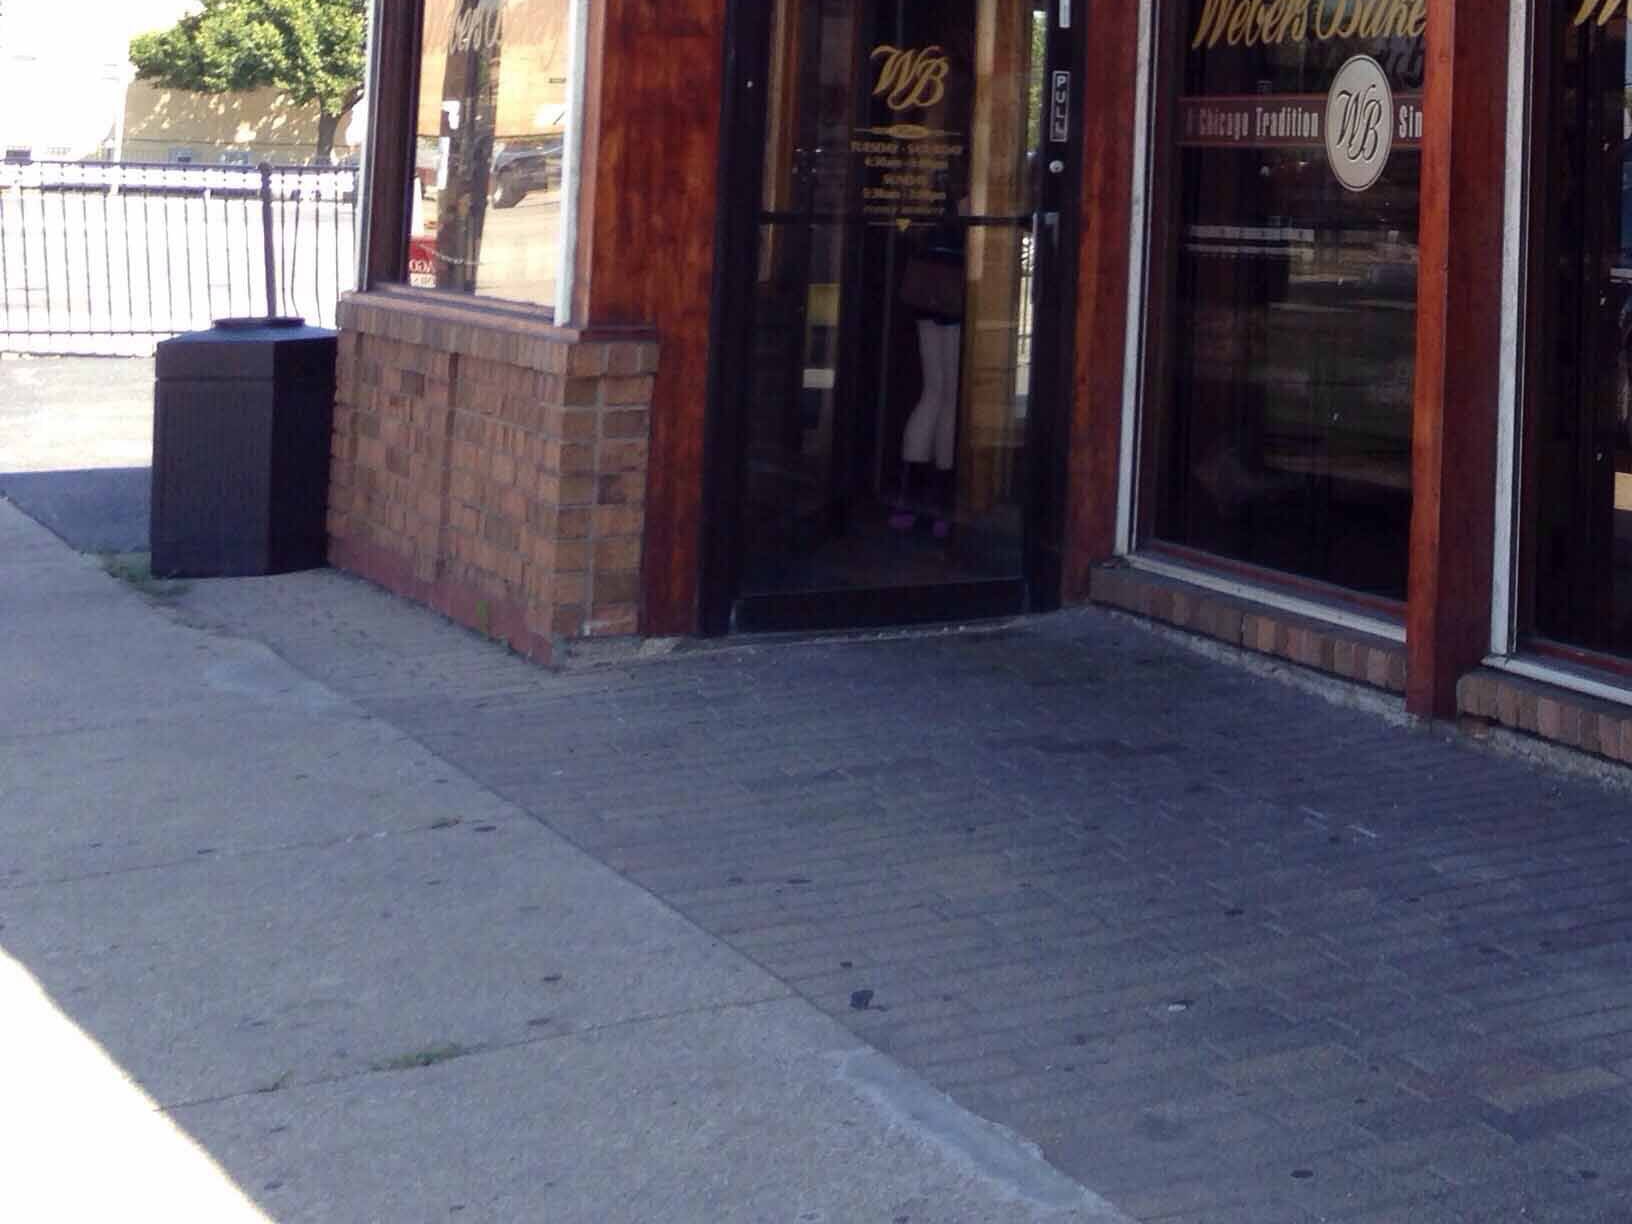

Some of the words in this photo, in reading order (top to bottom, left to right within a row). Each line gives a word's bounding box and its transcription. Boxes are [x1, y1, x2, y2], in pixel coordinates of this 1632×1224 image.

[869, 45, 950, 111] WB
[1055, 75, 1067, 134] PULL
[1199, 107, 1250, 140] Chicago
[1256, 106, 1319, 138] Tradition
[1400, 104, 1424, 139] Sin
[1335, 83, 1382, 162] WB
